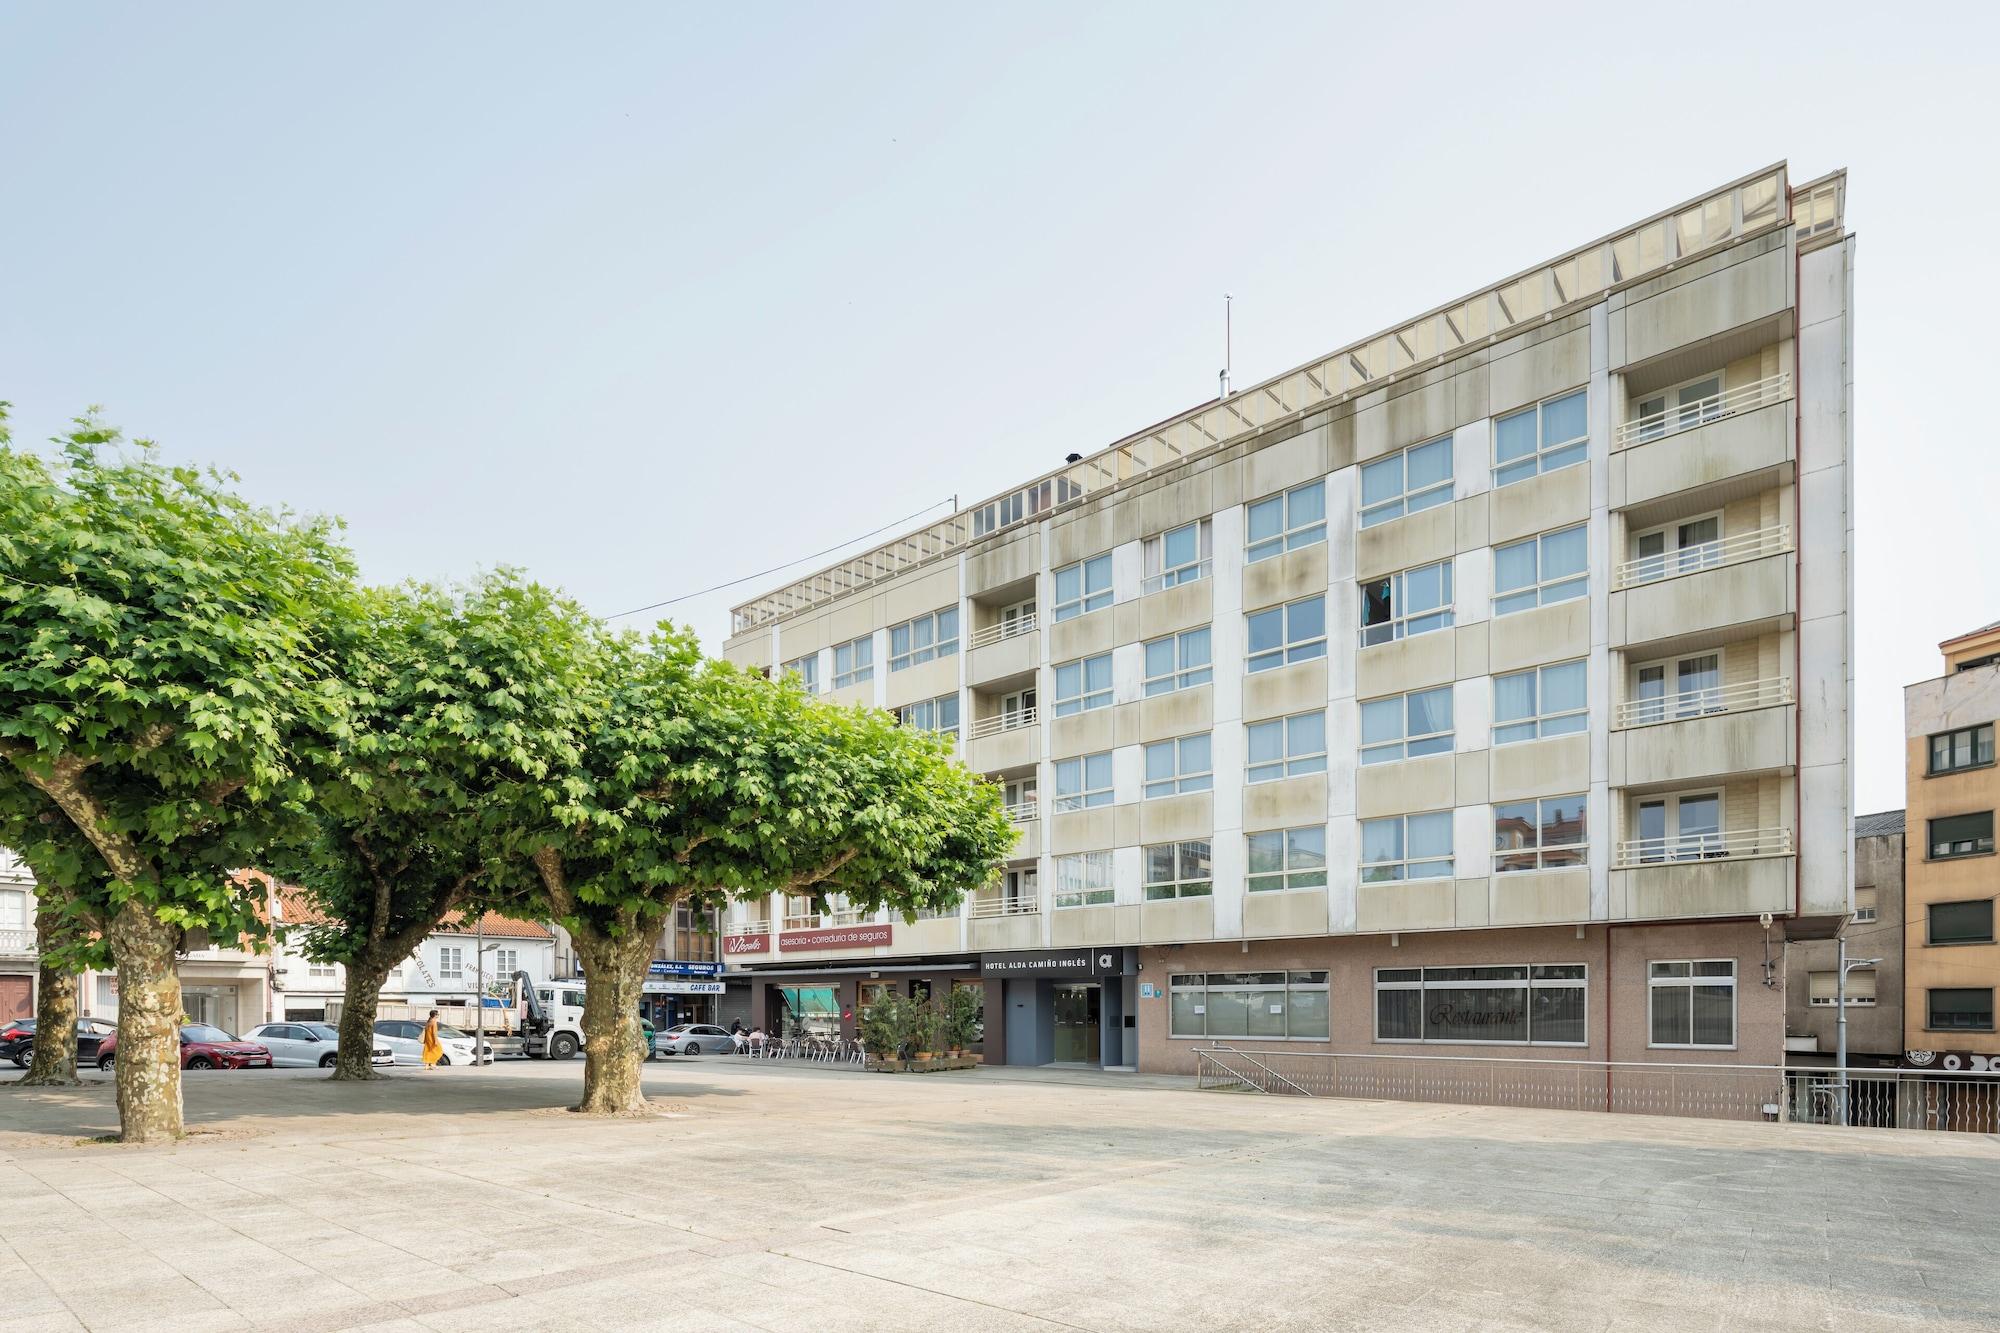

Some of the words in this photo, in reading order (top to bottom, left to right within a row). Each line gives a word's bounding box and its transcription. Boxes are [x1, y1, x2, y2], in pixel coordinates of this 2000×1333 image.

[848, 932, 857, 941] de
[859, 931, 888, 942] seguros
[985, 962, 1006, 970] HOTEL
[1009, 961, 1027, 969] ALDA
[1028, 959, 1057, 968] CAMIÑO
[1059, 957, 1086, 967] INGLÉS
[690, 984, 706, 992] CAFE
[1429, 1003, 1523, 1025] Restaurante
